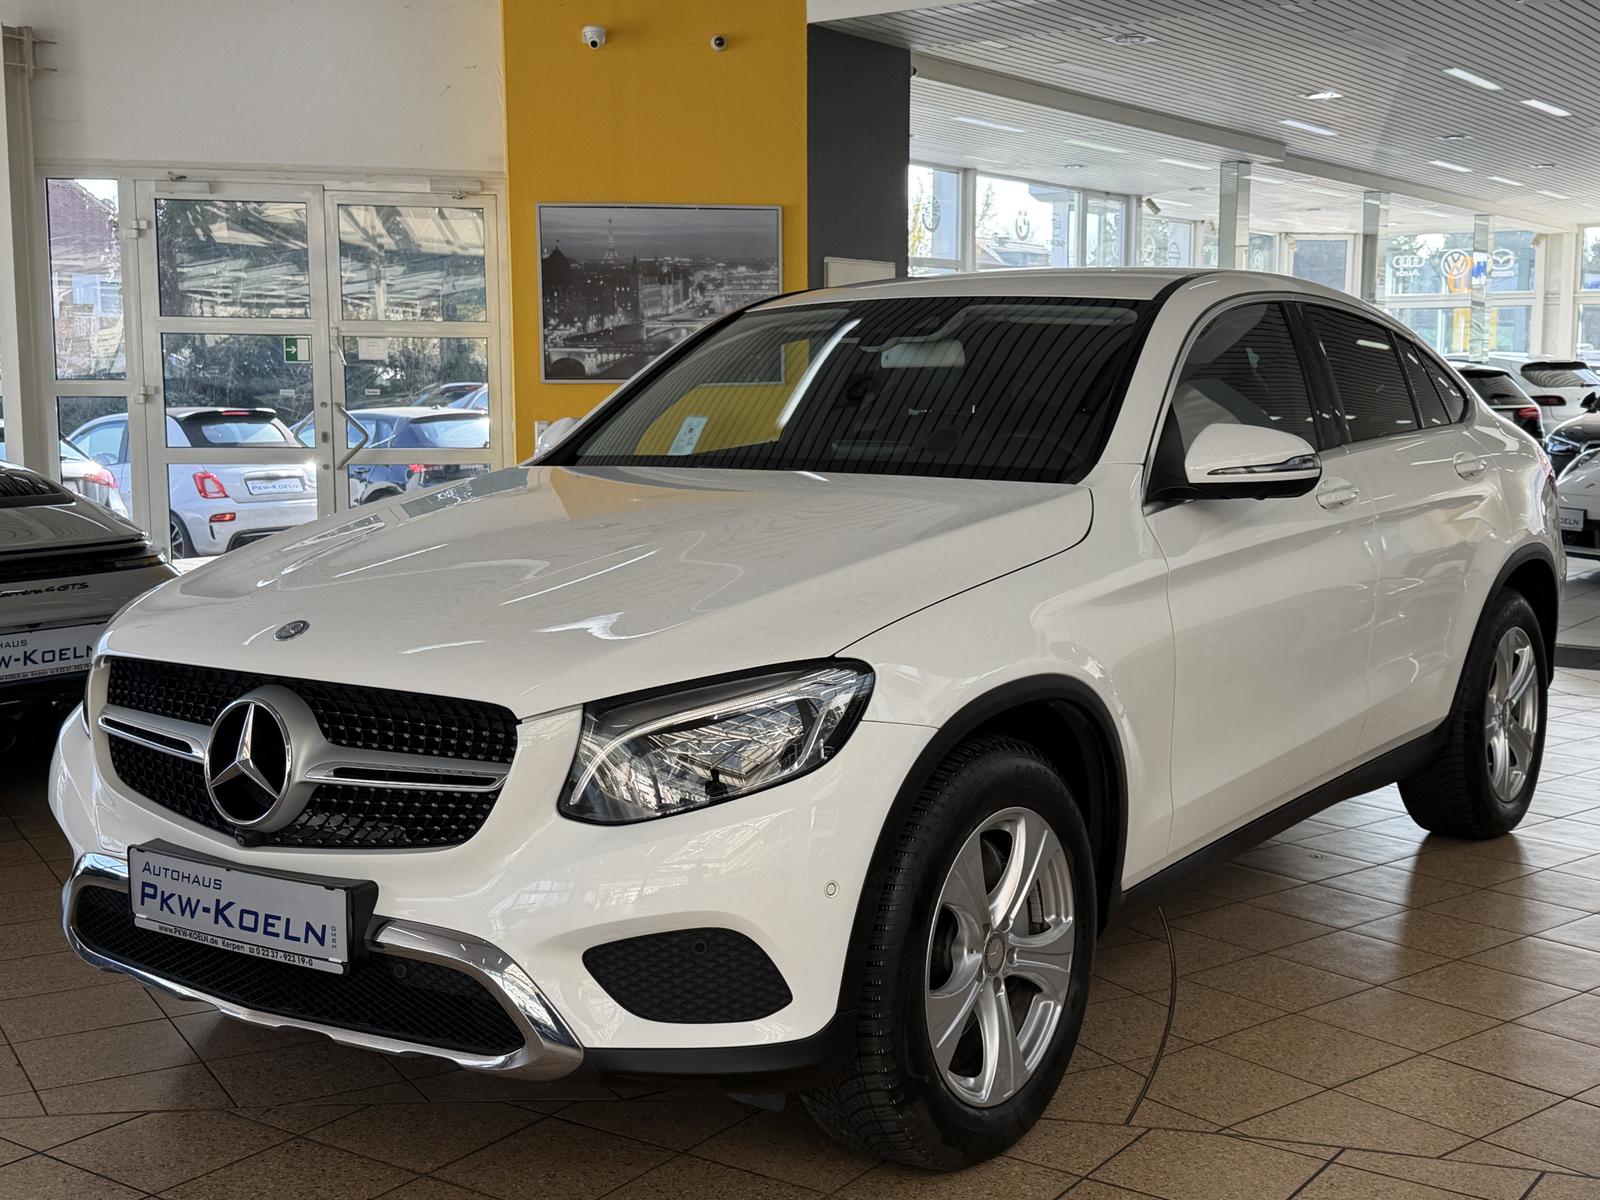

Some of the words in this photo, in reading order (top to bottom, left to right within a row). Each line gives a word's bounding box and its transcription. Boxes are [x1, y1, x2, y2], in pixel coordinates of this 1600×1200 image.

[56, 582, 89, 592] GTS
[142, 861, 222, 890] AUTOHAUS
[140, 881, 327, 947] PKW-KOELN
[158, 925, 219, 945] www.PKW-KOELN.de
[222, 941, 245, 952] Kerpen
